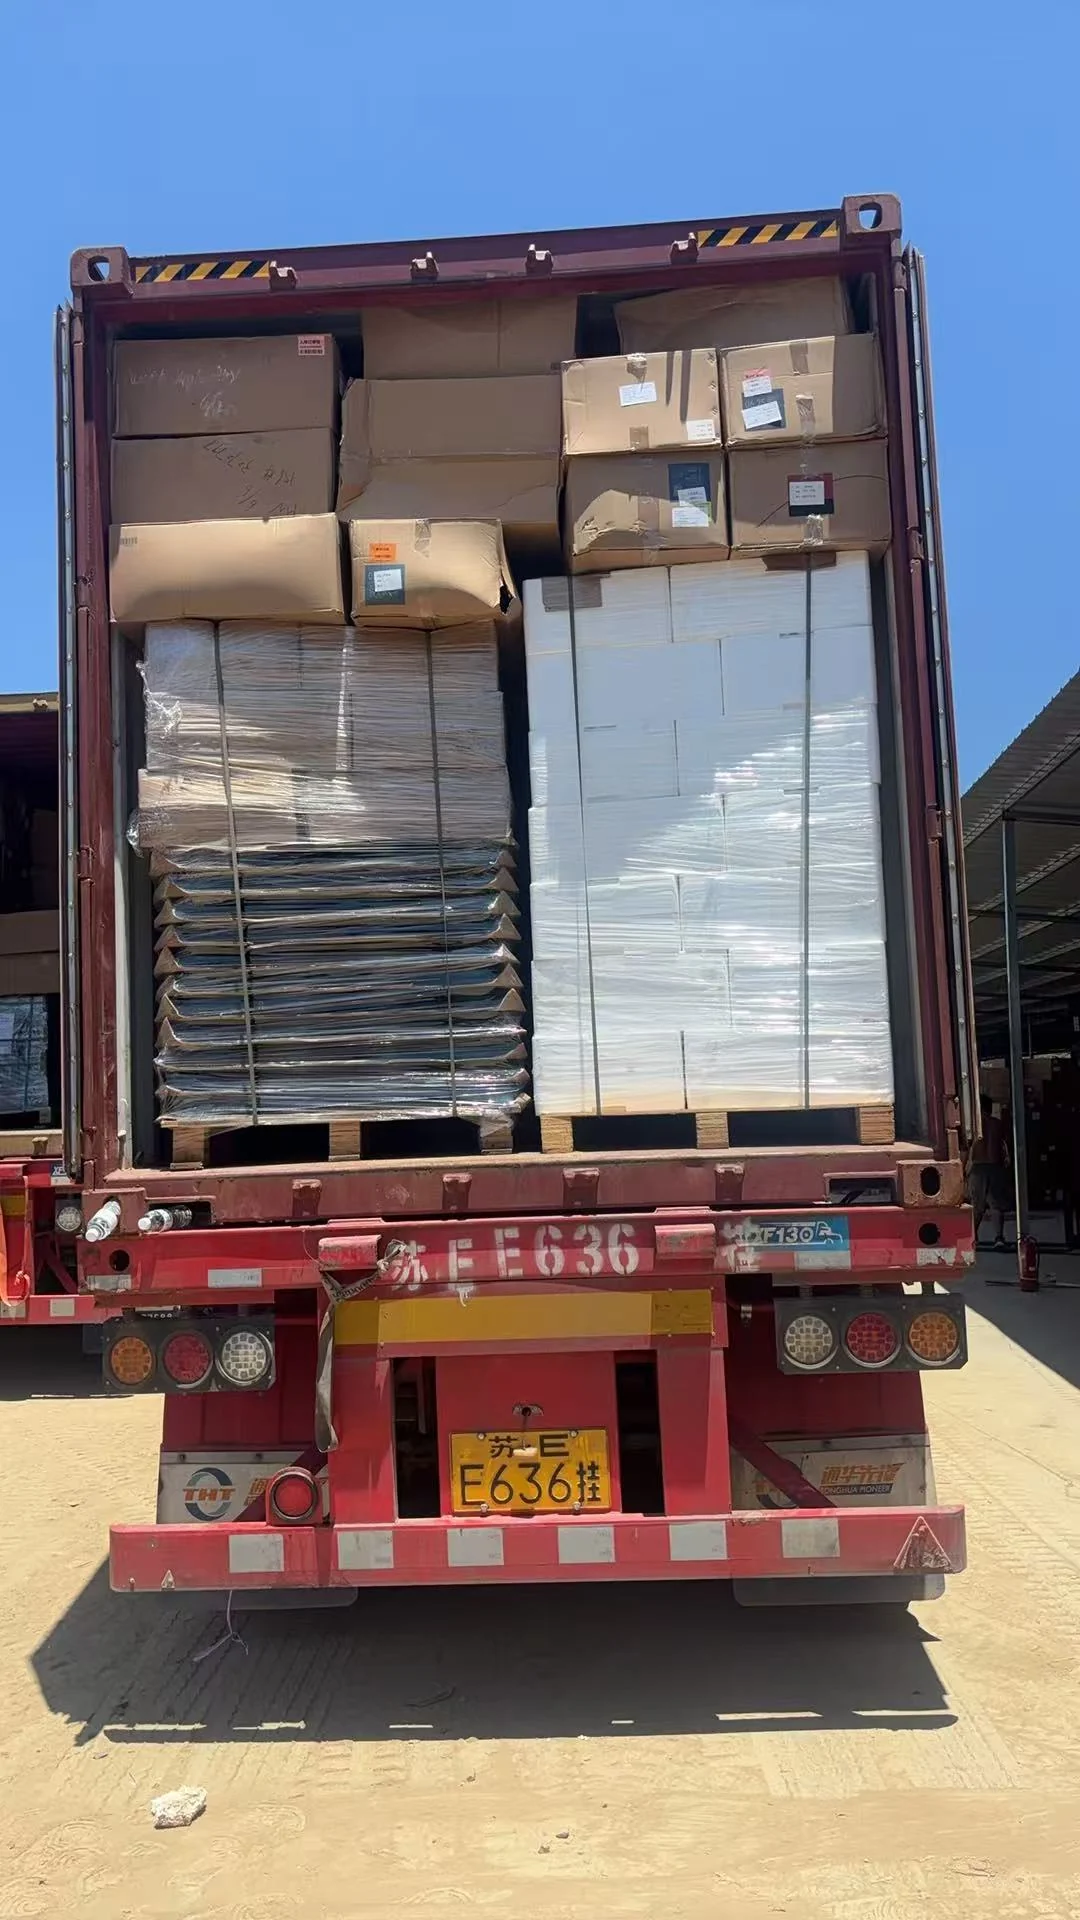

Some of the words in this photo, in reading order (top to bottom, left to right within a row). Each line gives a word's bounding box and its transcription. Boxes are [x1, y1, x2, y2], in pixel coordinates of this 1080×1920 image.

[459, 1461, 602, 1506] E636挂
[859, 1485, 890, 1494] PIONEER
[183, 1488, 236, 1501] THT
